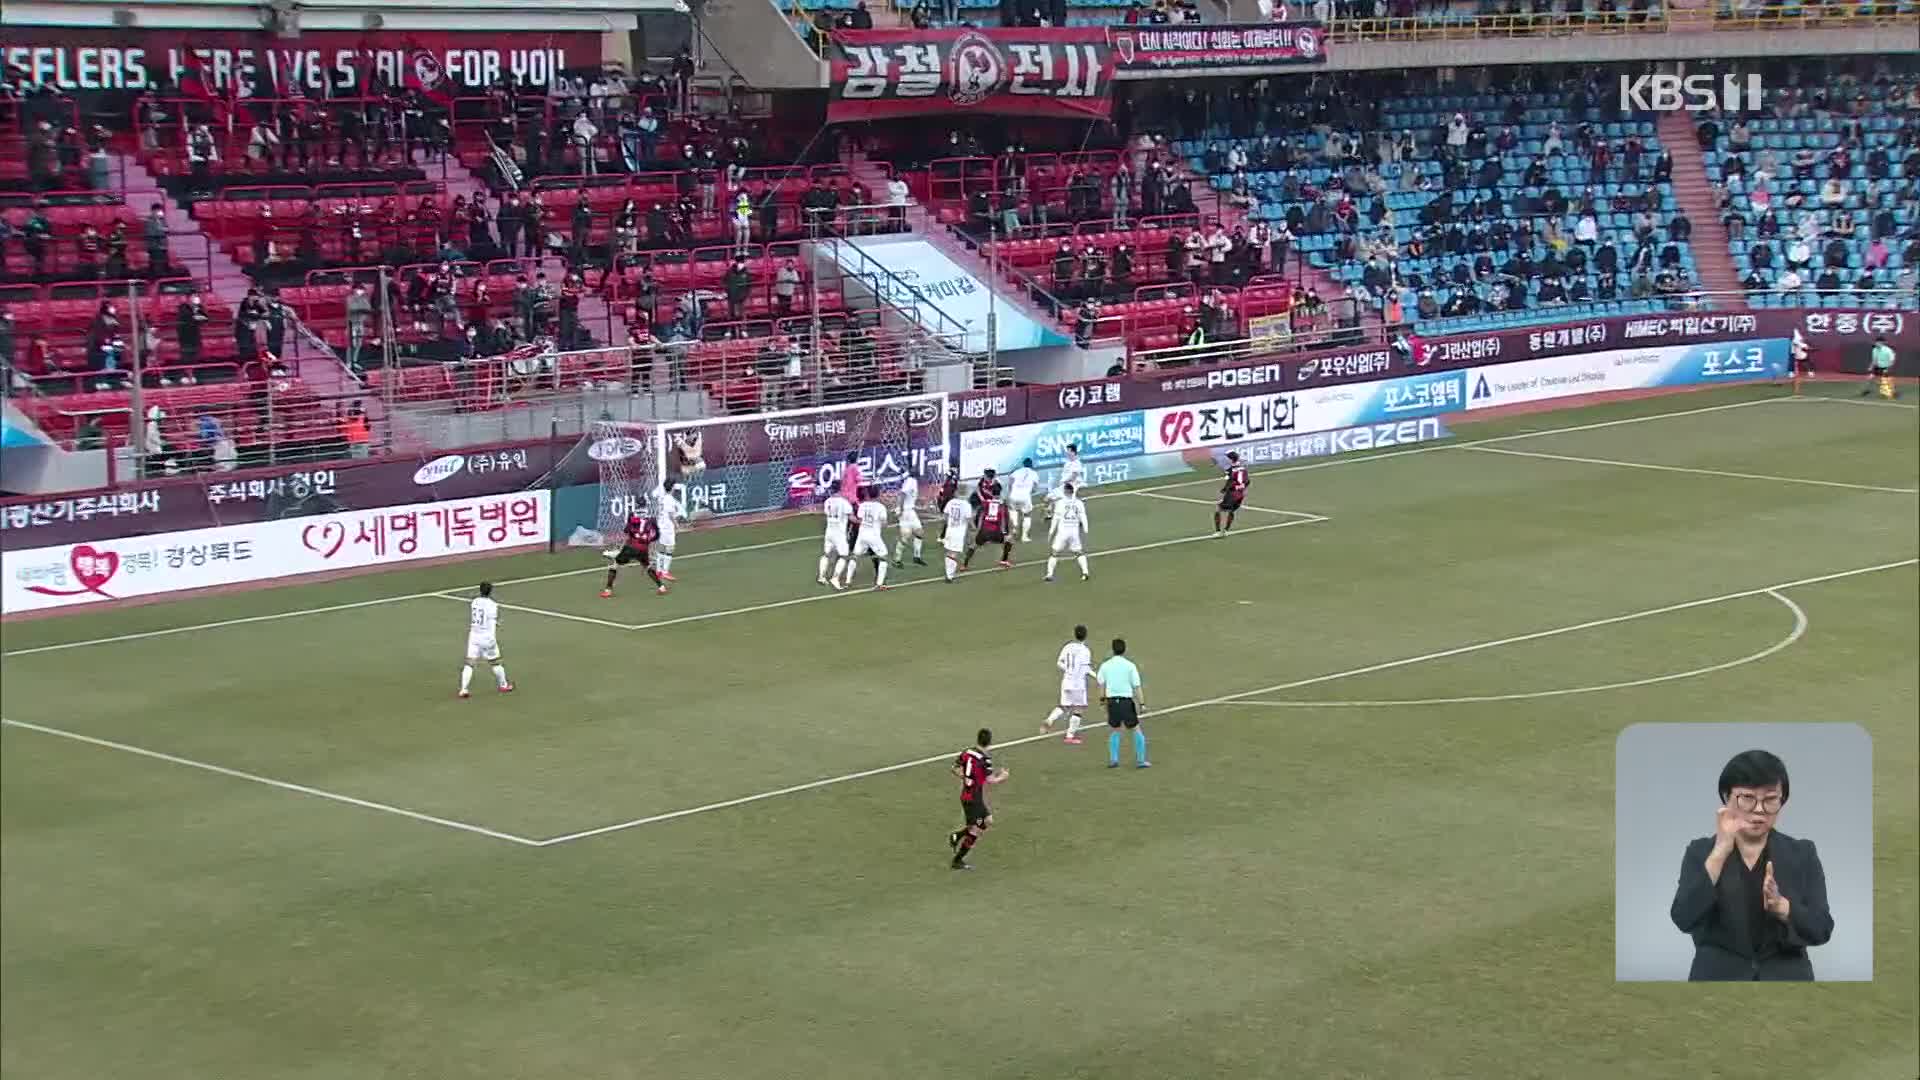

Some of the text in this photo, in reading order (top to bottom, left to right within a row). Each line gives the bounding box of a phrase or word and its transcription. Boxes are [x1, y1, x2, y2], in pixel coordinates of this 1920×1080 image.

[446, 50, 501, 86] FOR
[1008, 44, 1102, 97] 전사
[1319, 351, 1390, 378] 포우산업(주)
[1702, 347, 1764, 376] 포스코
[1199, 395, 1299, 441] 조선내화
[354, 497, 539, 555] 세명기독병원
